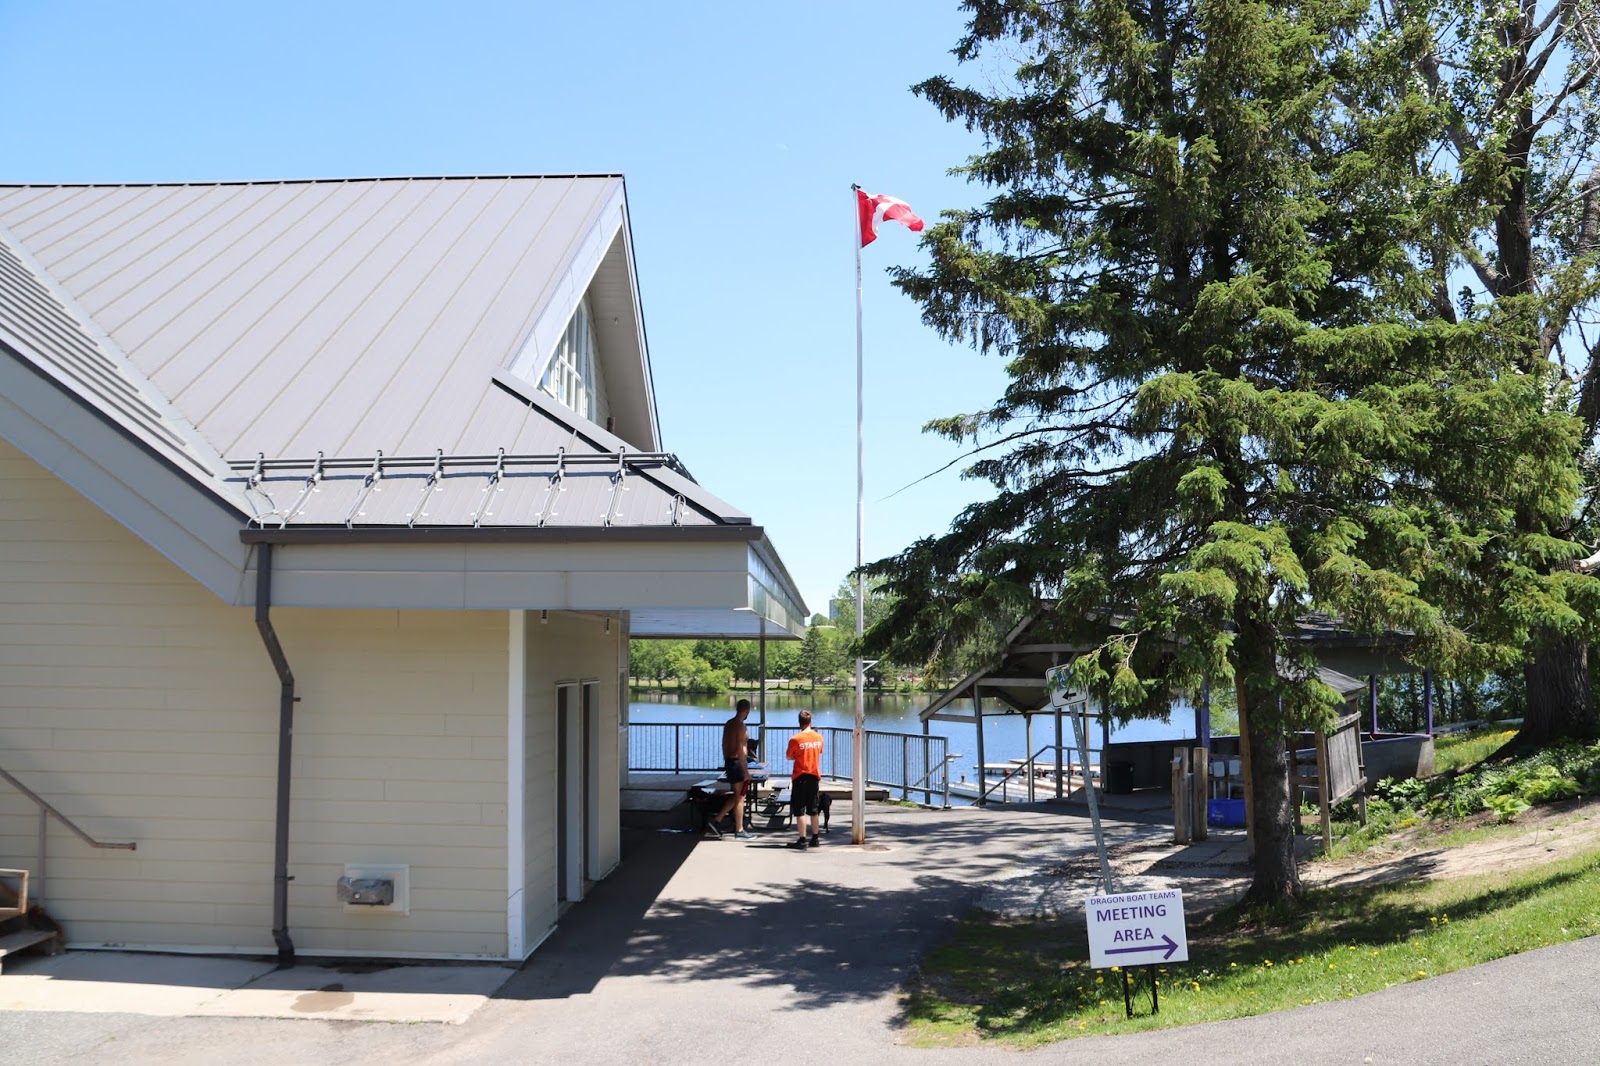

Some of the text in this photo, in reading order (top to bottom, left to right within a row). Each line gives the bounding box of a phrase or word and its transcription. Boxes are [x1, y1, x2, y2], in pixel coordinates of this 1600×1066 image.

[799, 741, 822, 750] STAFF
[1090, 891, 1176, 905] DRAGON BOAT TEAMS
[1096, 904, 1167, 922] MEETING
[1113, 927, 1154, 943] AREA
